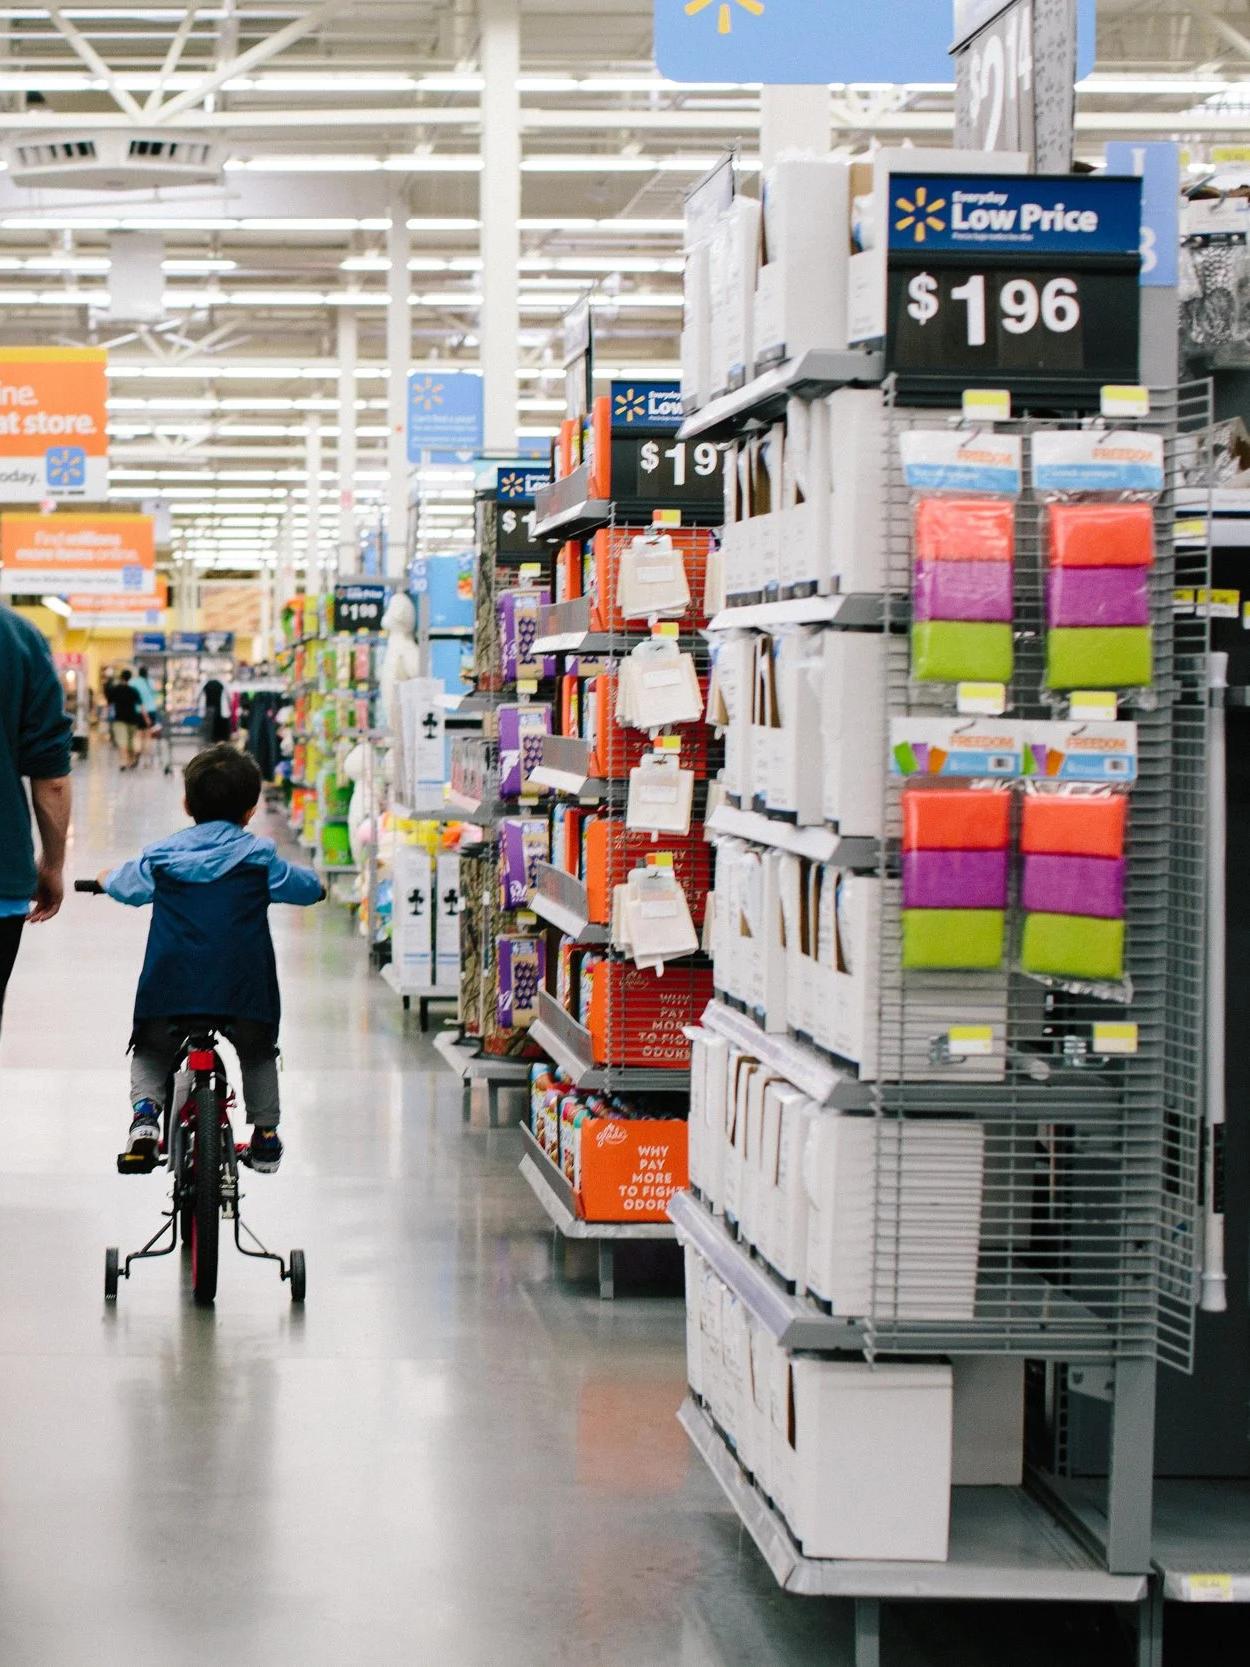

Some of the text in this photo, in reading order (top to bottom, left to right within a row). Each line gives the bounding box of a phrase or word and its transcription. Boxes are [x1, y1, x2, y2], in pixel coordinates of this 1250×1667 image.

[952, 190, 1008, 205] Everyday
[952, 202, 1098, 232] Low Price
[22, 413, 98, 435] store.
[640, 440, 718, 486] $19
[950, 736, 1014, 748] FREEDOM
[659, 993, 691, 1005] WHY
[660, 1008, 686, 1018] PAY
[638, 1031, 690, 1045] TO FIG
[596, 1122, 628, 1148] glade
[637, 1145, 669, 1157] WHY
[639, 1159, 665, 1170] PAY
[631, 1172, 672, 1184] MORE
[618, 1185, 638, 1197] TO
[623, 1198, 669, 1211] ODOR
